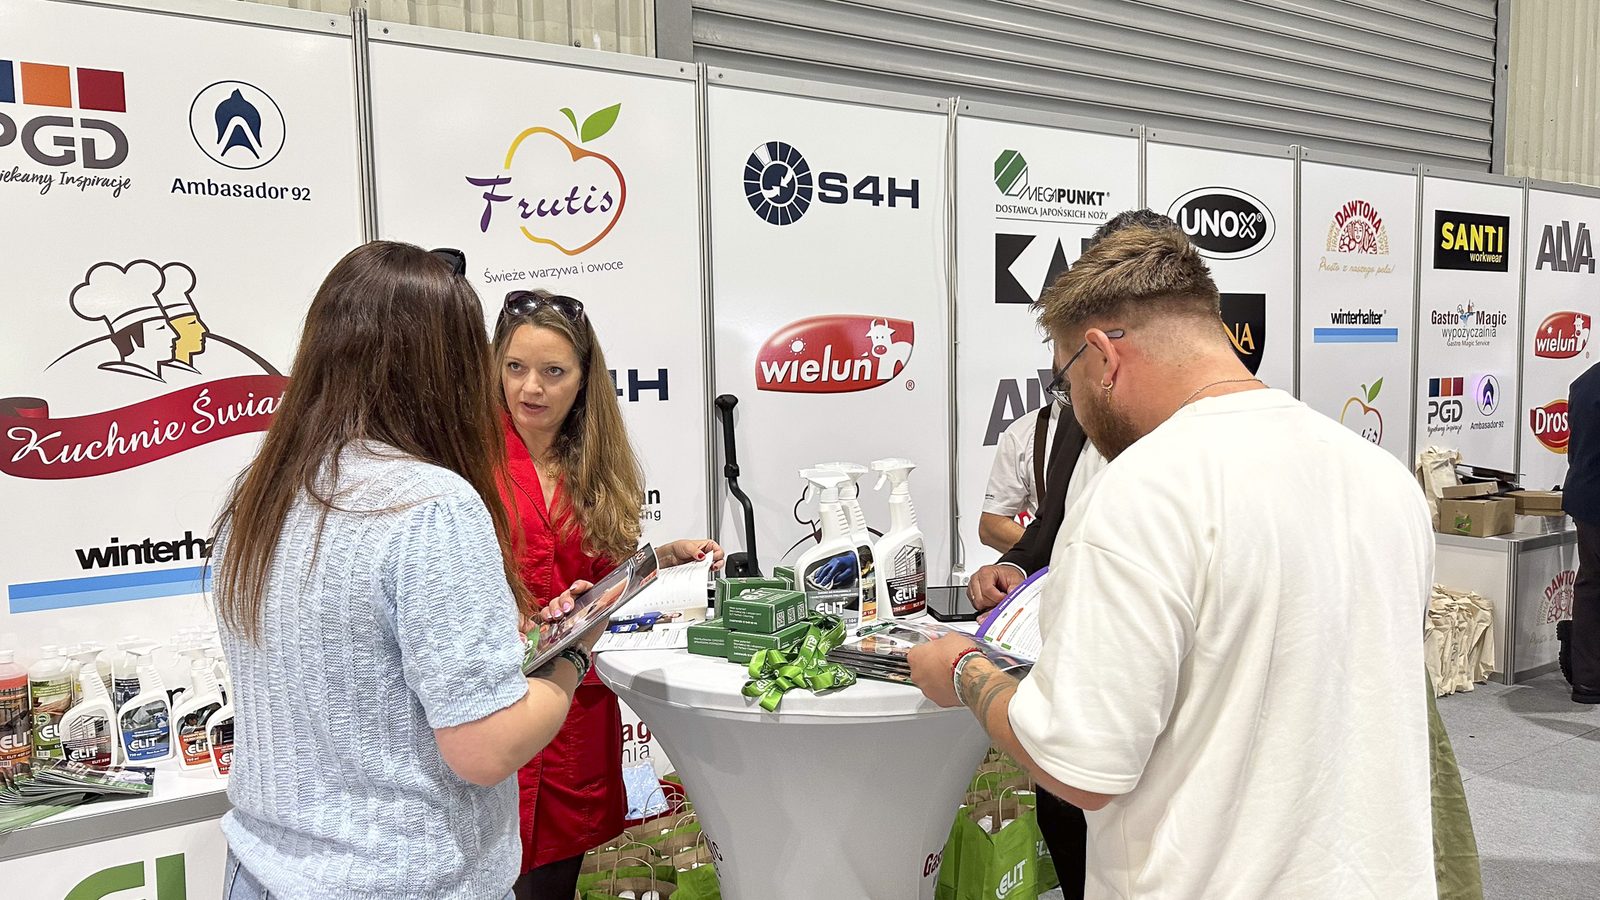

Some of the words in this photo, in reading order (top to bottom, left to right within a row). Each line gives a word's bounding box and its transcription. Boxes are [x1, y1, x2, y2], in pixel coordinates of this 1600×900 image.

[0, 112, 129, 169] GD
[0, 165, 55, 195] iekamy
[59, 171, 131, 198] Inspiracje
[171, 178, 289, 200] Ambasador
[291, 187, 312, 201] 92
[817, 171, 920, 209] S4H
[465, 175, 613, 233] Frutis
[995, 204, 1039, 216] DOSTAWCA
[1040, 207, 1086, 219] JAPOŃSKICH
[1088, 210, 1109, 220] NOŻY
[1335, 200, 1382, 235] DAWTONA
[1441, 221, 1504, 253] SANTI
[995, 233, 1093, 304] KA
[1470, 252, 1502, 263] workwear
[483, 267, 526, 283] Świeże
[528, 265, 579, 279] warzywa
[586, 260, 624, 273] owoce
[1331, 309, 1383, 325] winterhalter
[1431, 310, 1459, 325] Gastro
[1475, 310, 1507, 328] Magic
[1441, 326, 1497, 341] wypożyczalnia
[1536, 330, 1576, 353] wieluń
[760, 344, 873, 384] wieluń
[1427, 400, 1463, 424] PGD
[1535, 407, 1568, 435] Dros
[1470, 420, 1499, 430] Ambasador
[7, 421, 187, 465] Kuchnie
[75, 531, 214, 570] winterha
[895, 585, 918, 602] ELIT
[1545, 570, 1575, 601] DAWTO
[815, 601, 846, 616] ELIT
[71, 747, 98, 759] ELIT
[130, 738, 158, 749] ELIT
[998, 859, 1026, 893] ELIT
